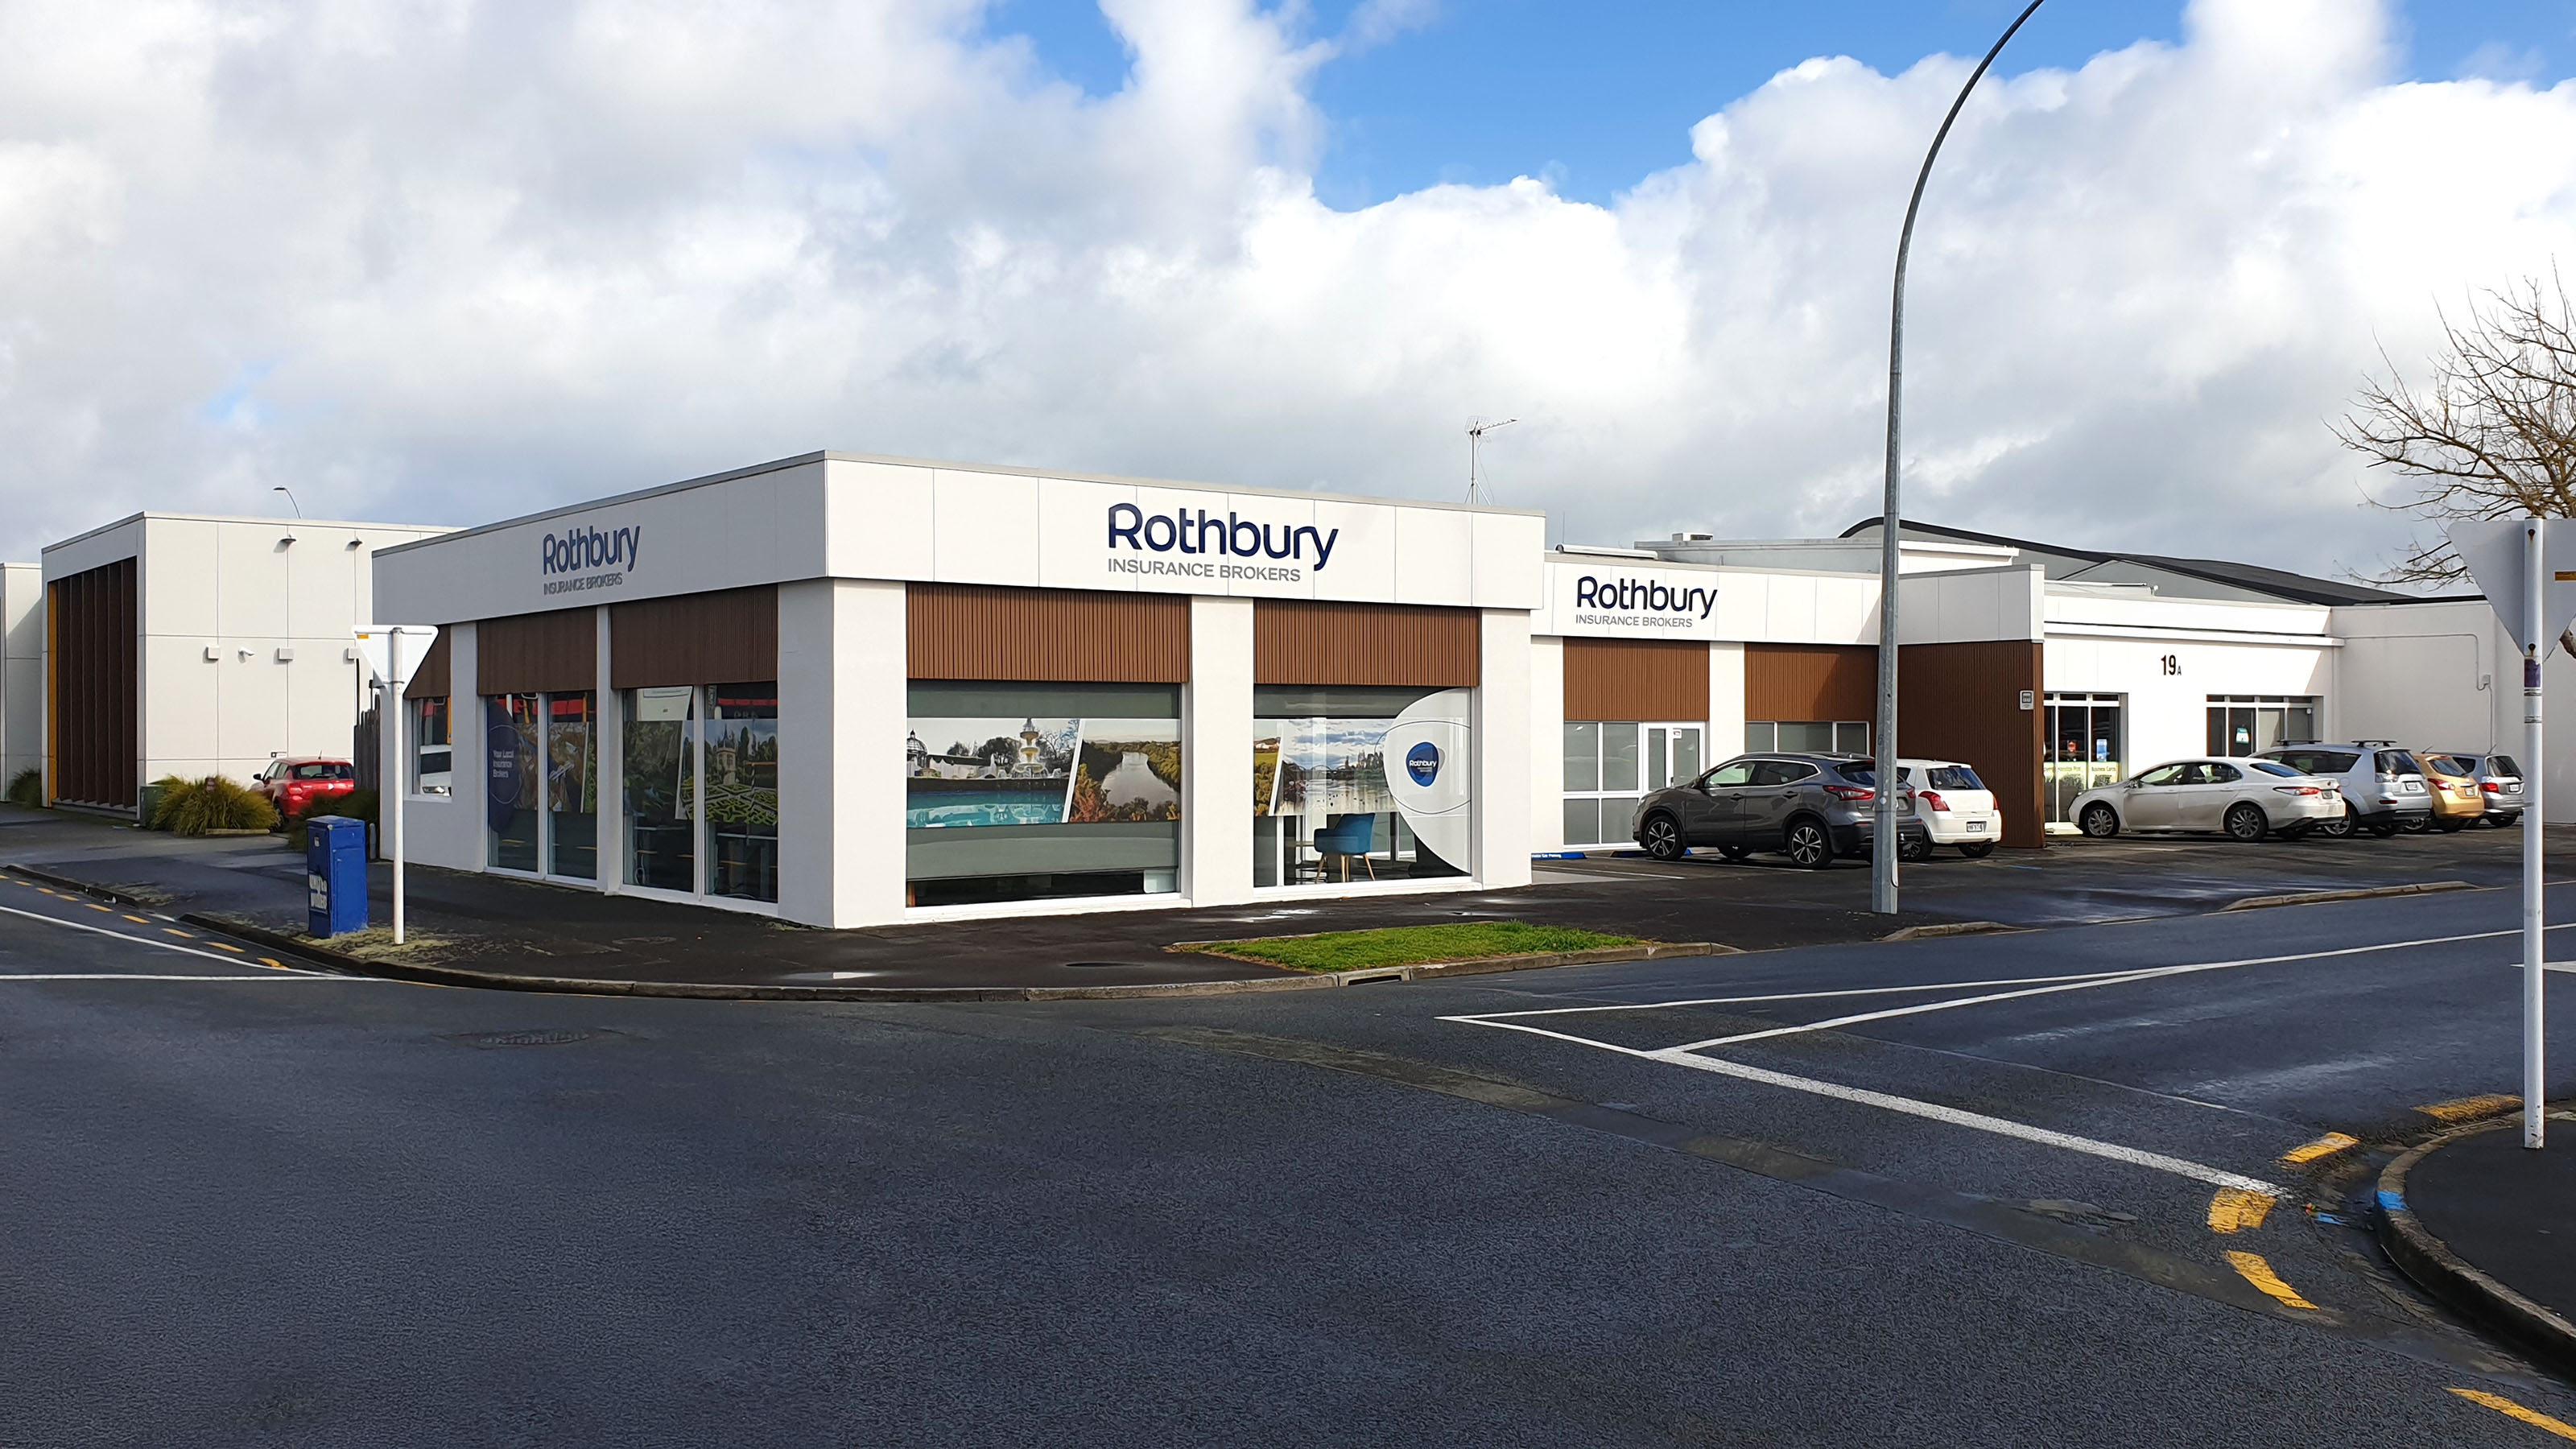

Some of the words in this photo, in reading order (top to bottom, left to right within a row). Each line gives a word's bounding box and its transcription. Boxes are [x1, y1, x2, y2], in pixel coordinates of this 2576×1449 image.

[1108, 502, 1339, 572] Rothbury
[543, 525, 641, 576] Rothbury
[1108, 558, 1215, 578] INSURANCE
[1220, 565, 1302, 582] BROKERS
[543, 577, 584, 596] INSURANCE
[586, 572, 623, 589] BROKERS
[1576, 576, 1718, 620] Rothbury
[1575, 614, 1640, 626] INSURANCE
[1642, 617, 1693, 628] BROKERS
[1409, 760, 1438, 768] Rothbury
